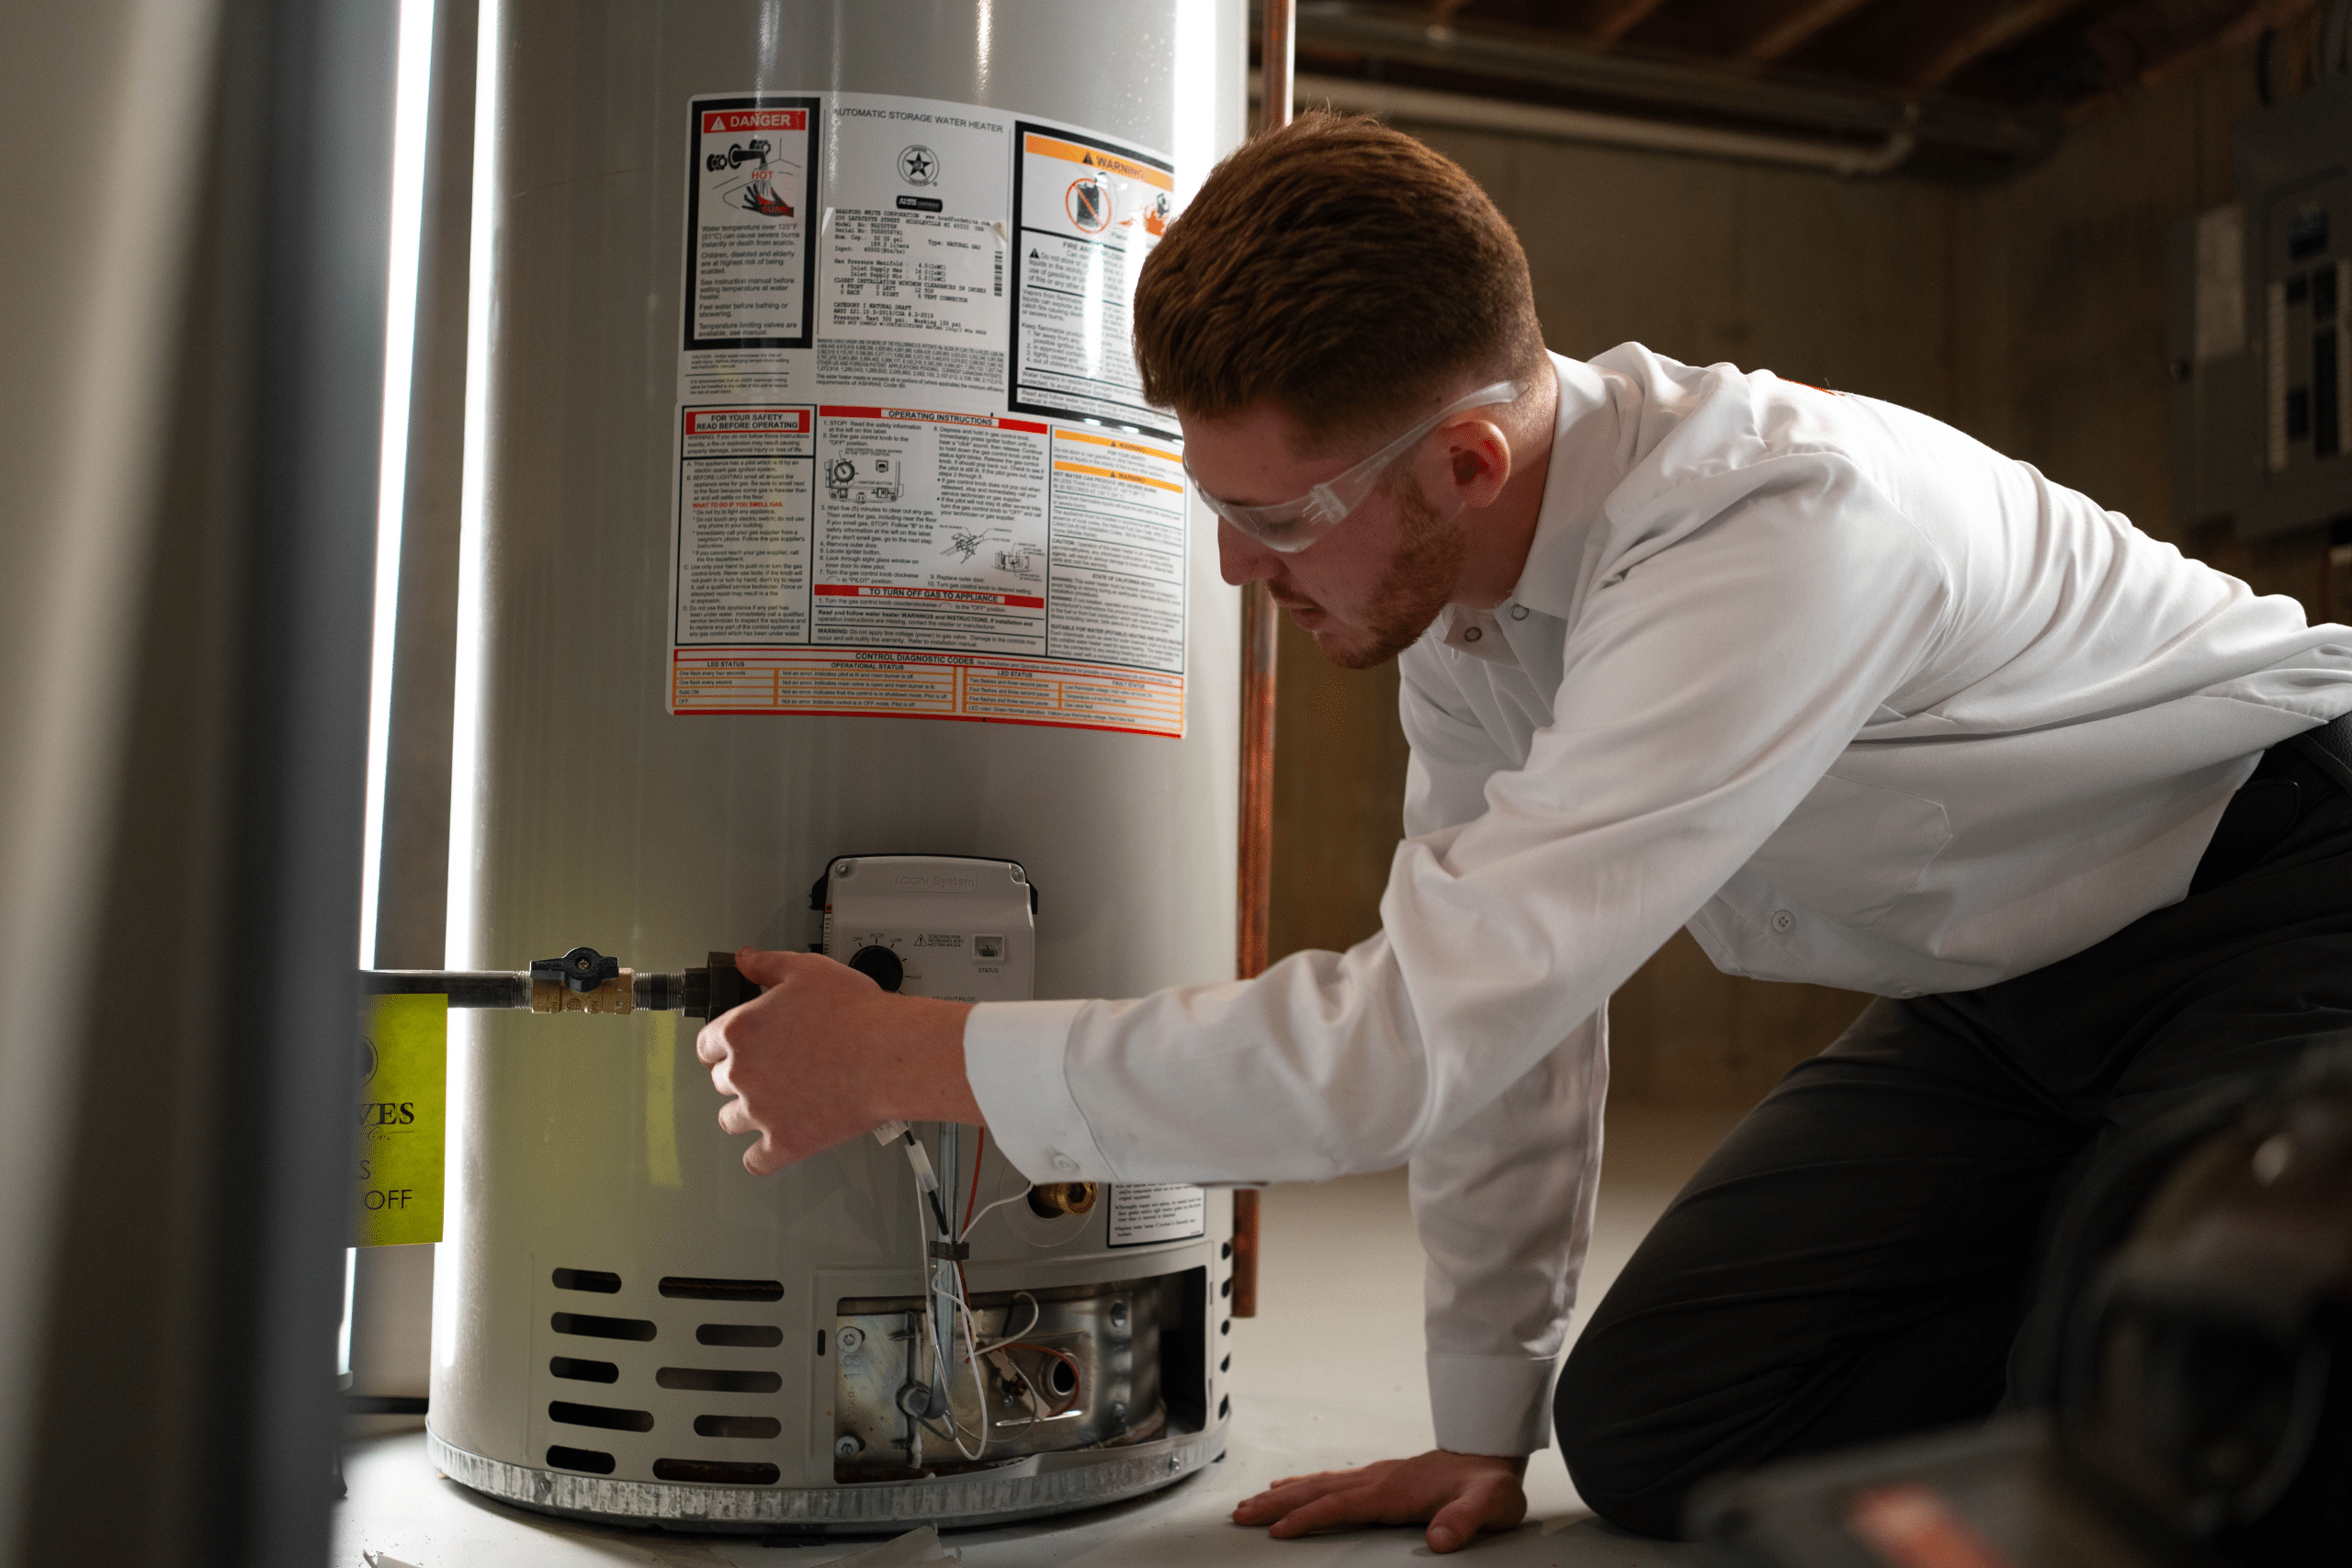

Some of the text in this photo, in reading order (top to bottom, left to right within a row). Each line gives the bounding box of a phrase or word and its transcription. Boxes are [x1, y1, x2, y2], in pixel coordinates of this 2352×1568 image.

[729, 114, 791, 128] DANGER
[888, 111, 933, 123] STORAGE
[934, 115, 967, 127] WATER
[968, 120, 1003, 133] HEATER
[752, 170, 774, 180] HOT
[762, 206, 788, 214] BURN
[884, 210, 920, 219] CORPORATION
[721, 224, 760, 232] temperature
[755, 302, 779, 310] bathing
[698, 322, 738, 331] Temperature
[739, 321, 762, 330] limiting
[752, 413, 783, 422] SAFETY
[888, 411, 993, 425] OPERATING INSTRUCTIONS
[718, 422, 750, 430] BEFORE
[752, 422, 798, 430] OPERATING
[956, 593, 999, 603] APPLIANCE
[901, 612, 933, 620] WARNINGS
[946, 615, 989, 624] INSTRUCTIONS.
[995, 618, 1023, 626] installation
[855, 652, 974, 665] CONTROL DIAGNOSTIC CODES
[933, 875, 974, 887] System
[365, 1190, 413, 1211] OFF
